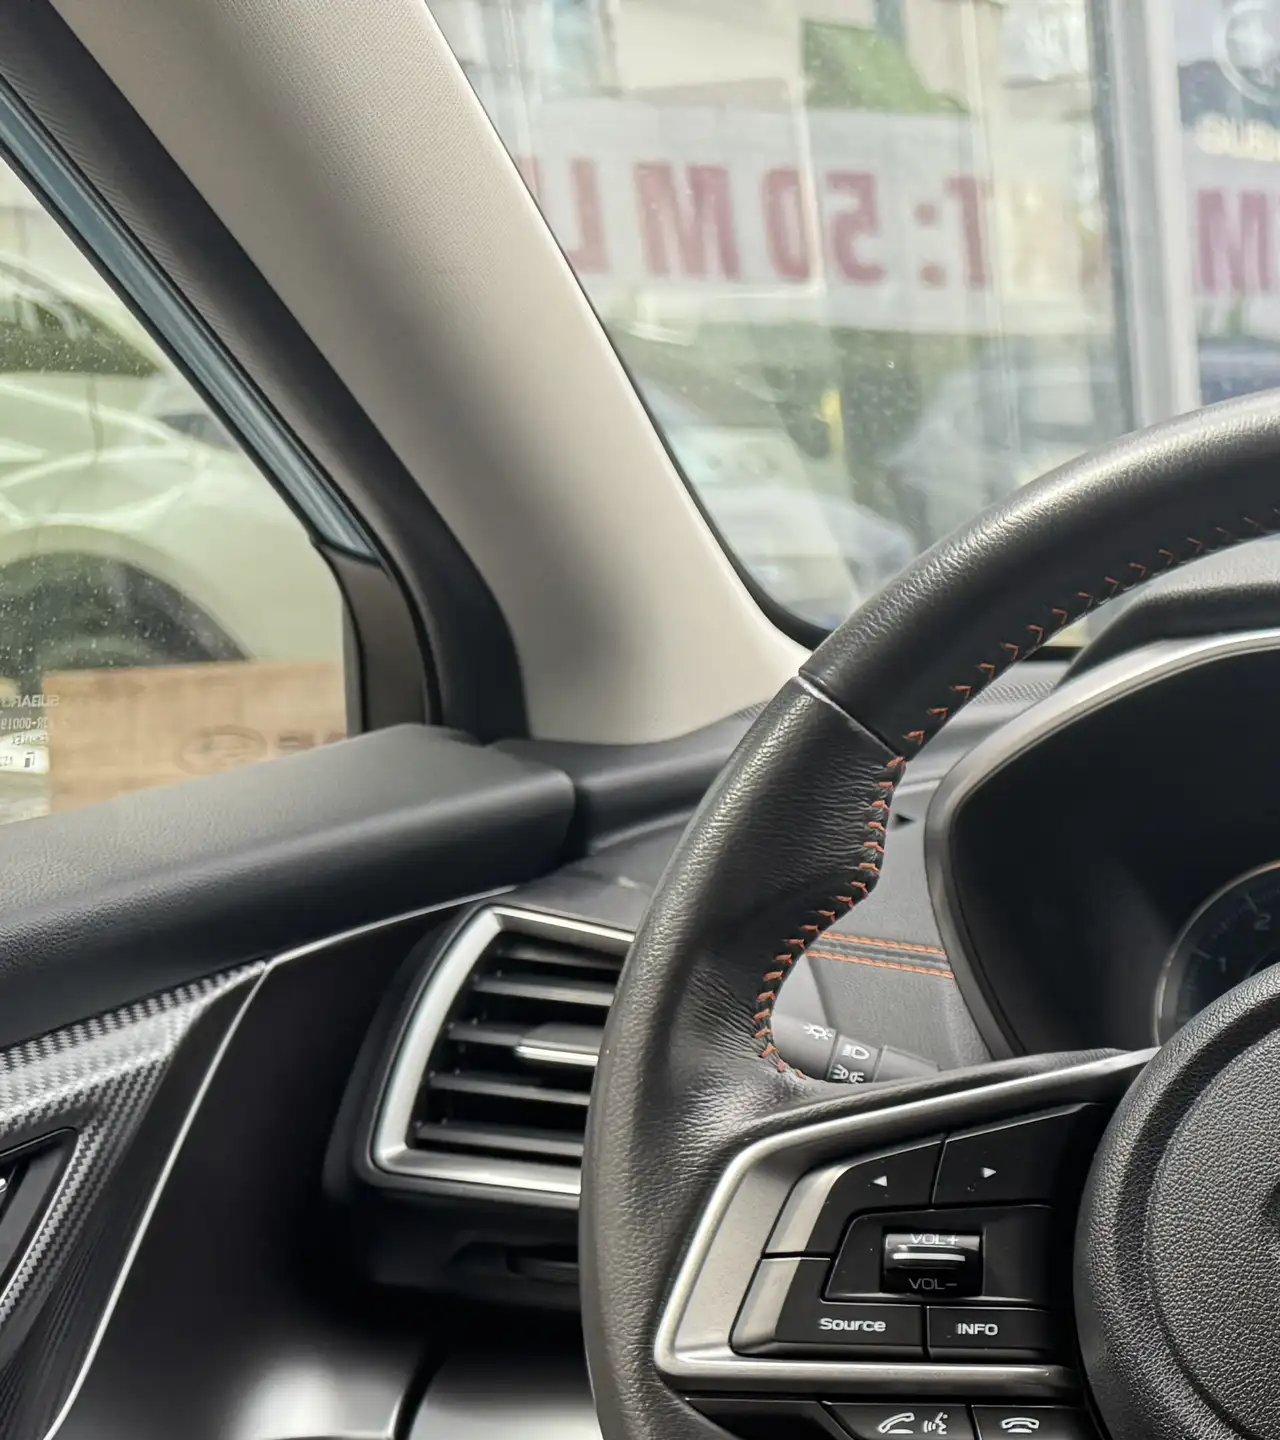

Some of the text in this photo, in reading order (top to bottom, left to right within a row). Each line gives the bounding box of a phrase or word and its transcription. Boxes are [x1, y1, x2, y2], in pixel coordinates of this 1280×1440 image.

[1254, 912, 1271, 930] 2
[819, 1317, 886, 1332] Source
[957, 1322, 998, 1336] INFO
